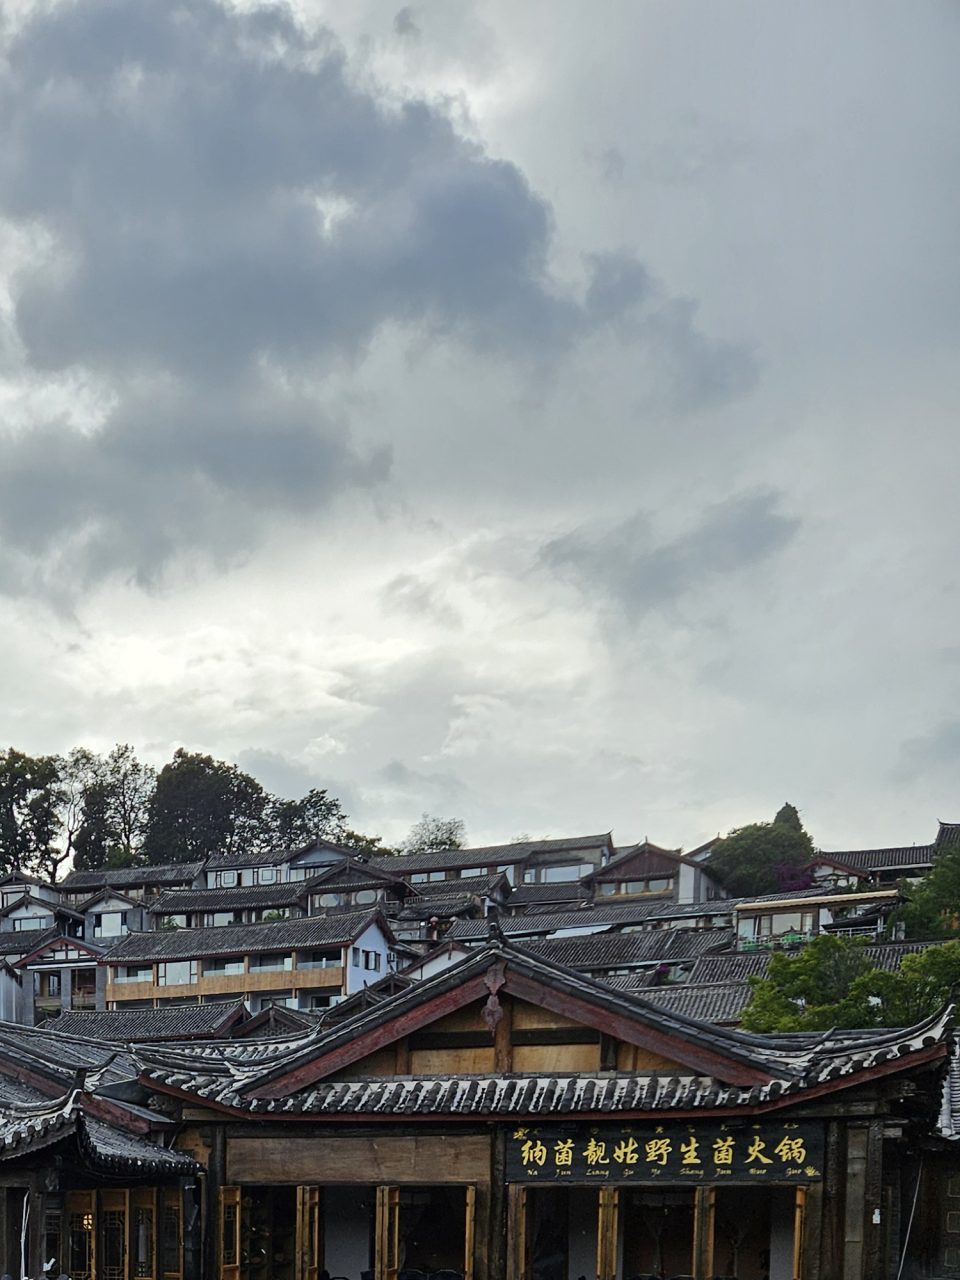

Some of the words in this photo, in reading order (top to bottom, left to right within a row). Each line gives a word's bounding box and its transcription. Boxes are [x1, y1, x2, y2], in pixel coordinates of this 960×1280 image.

[520, 1136, 808, 1166] 纳菌靓姑野生菌火锅
